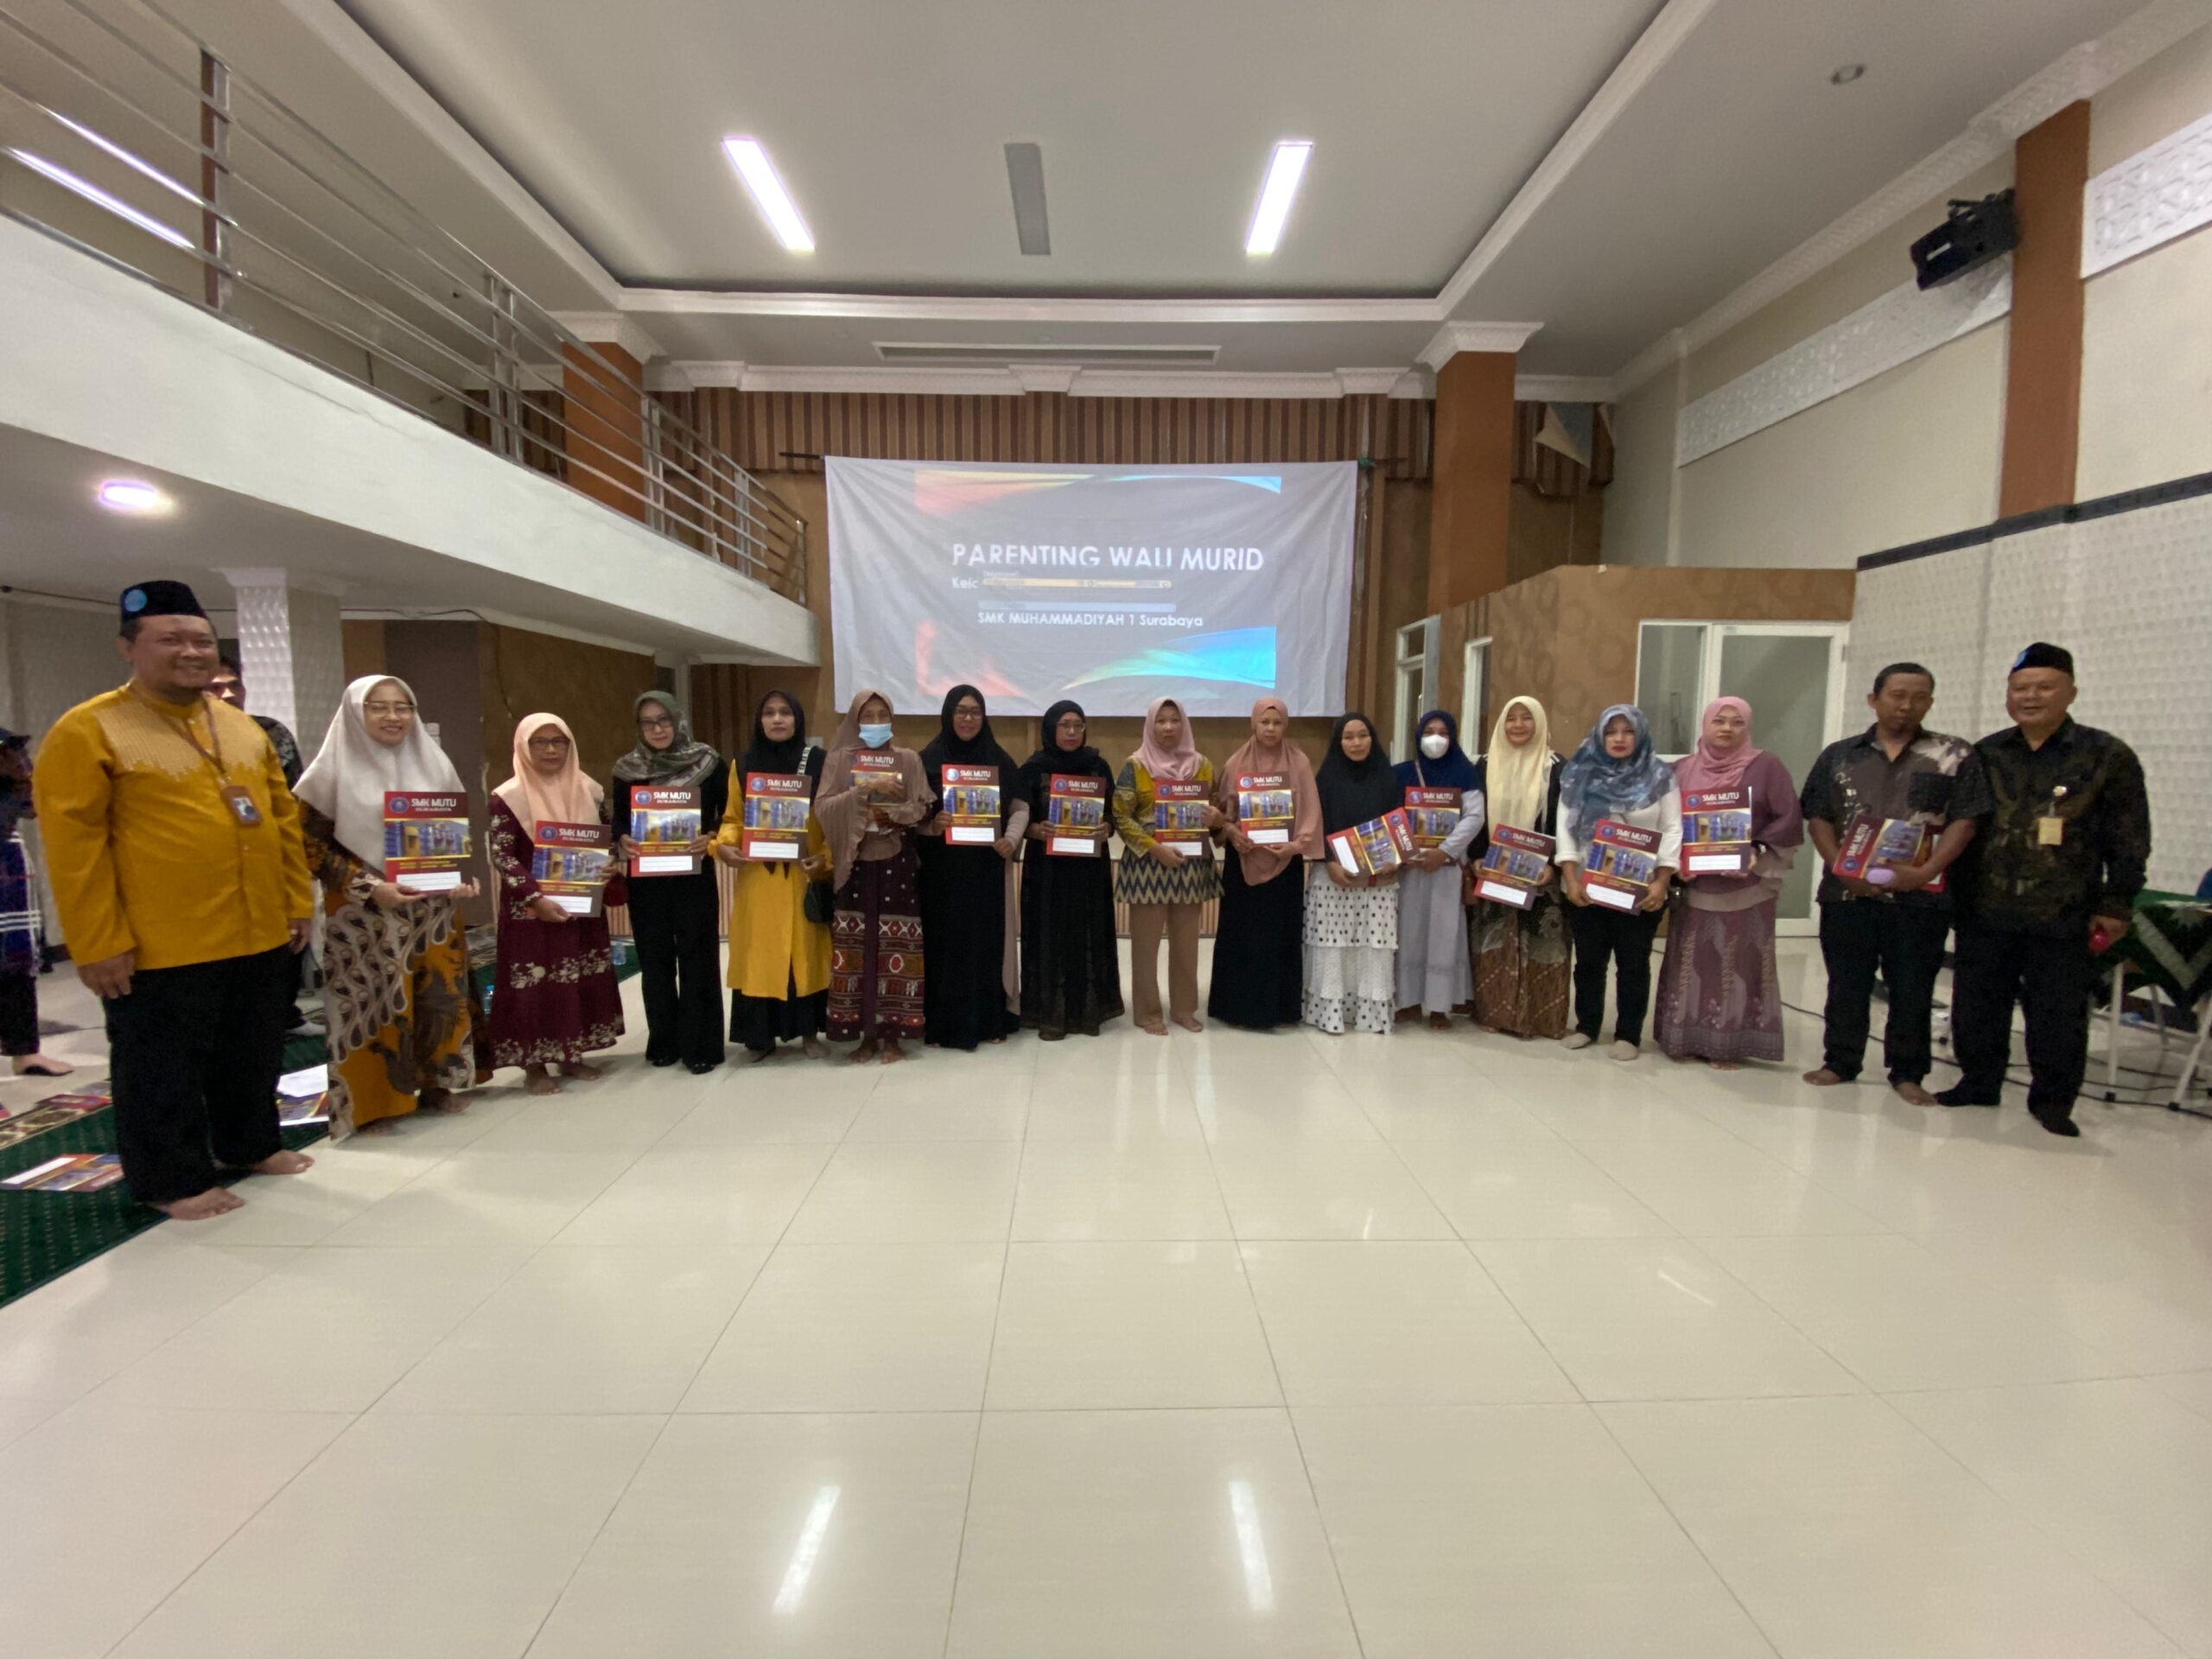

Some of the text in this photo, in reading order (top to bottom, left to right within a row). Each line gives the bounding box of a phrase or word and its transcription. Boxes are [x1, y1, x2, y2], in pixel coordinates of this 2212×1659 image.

[951, 543, 1264, 570] PARENTING WALI MURID
[977, 612, 1203, 629] SMK MUHAMMADIYAH 1 Surabaya
[782, 779, 802, 788] MUTU
[670, 791, 691, 800] MUTU
[1702, 791, 1739, 802] SMK MUTU
[411, 798, 456, 807] SMK MUTU
[559, 828, 600, 838] SMK MUTU
[1631, 832, 1652, 843] MUTU
